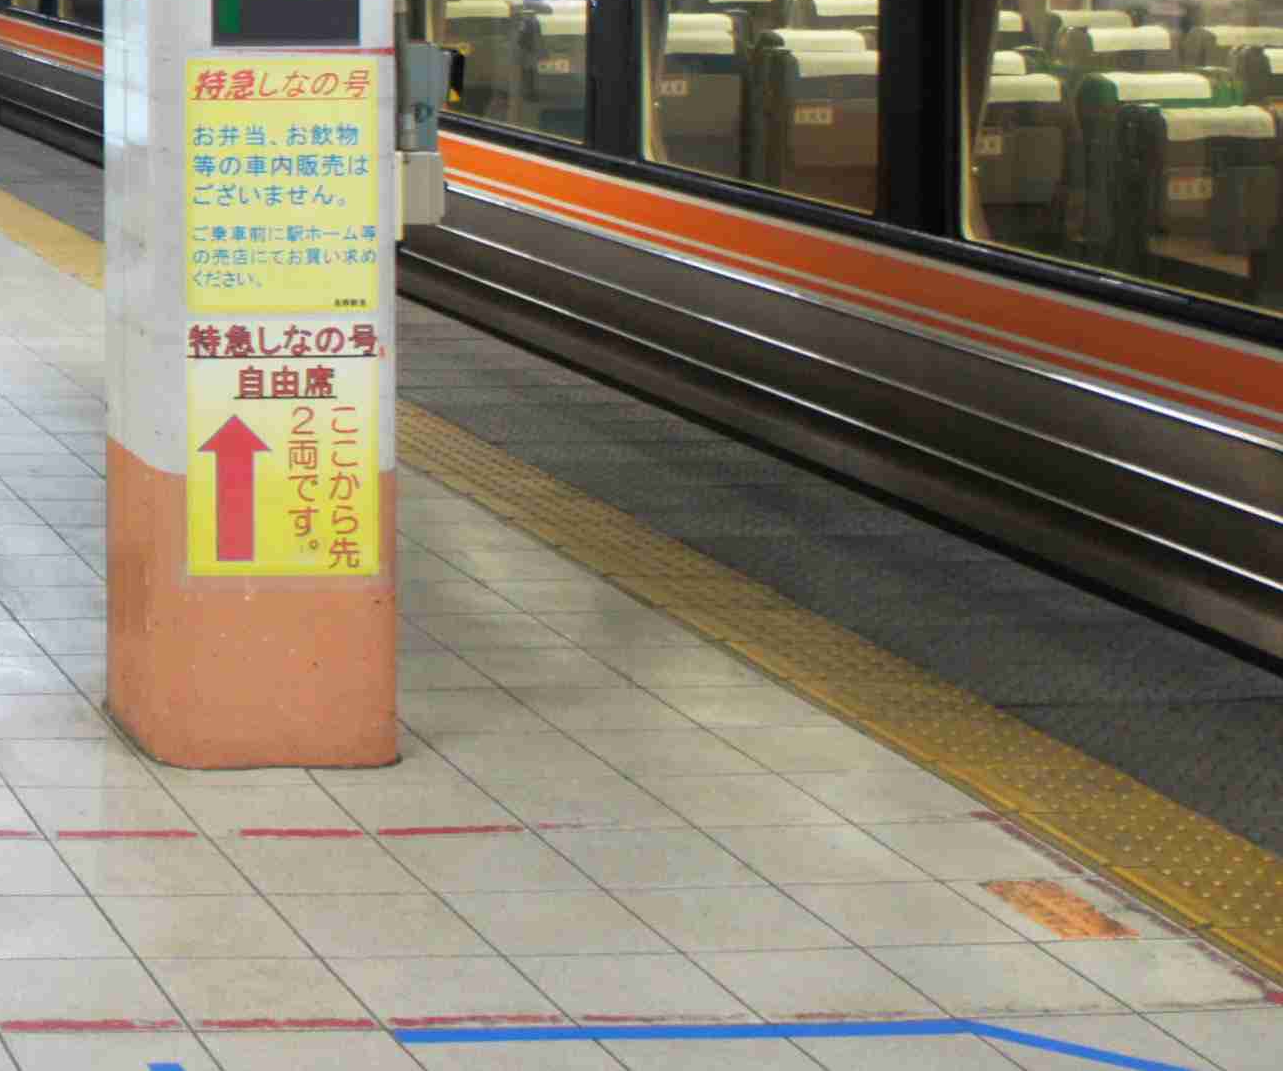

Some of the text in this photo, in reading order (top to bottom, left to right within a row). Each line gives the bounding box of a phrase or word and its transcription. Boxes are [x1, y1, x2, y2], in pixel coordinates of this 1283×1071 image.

[194, 69, 370, 99] 特急しなの号
[193, 124, 360, 147] お弁当、お飲物
[193, 155, 370, 178] 等の車内販売は
[193, 184, 347, 207] ございません。
[188, 324, 377, 356] 特急しなの号
[238, 365, 335, 400] 自由席
[328, 405, 360, 570] ここから先
